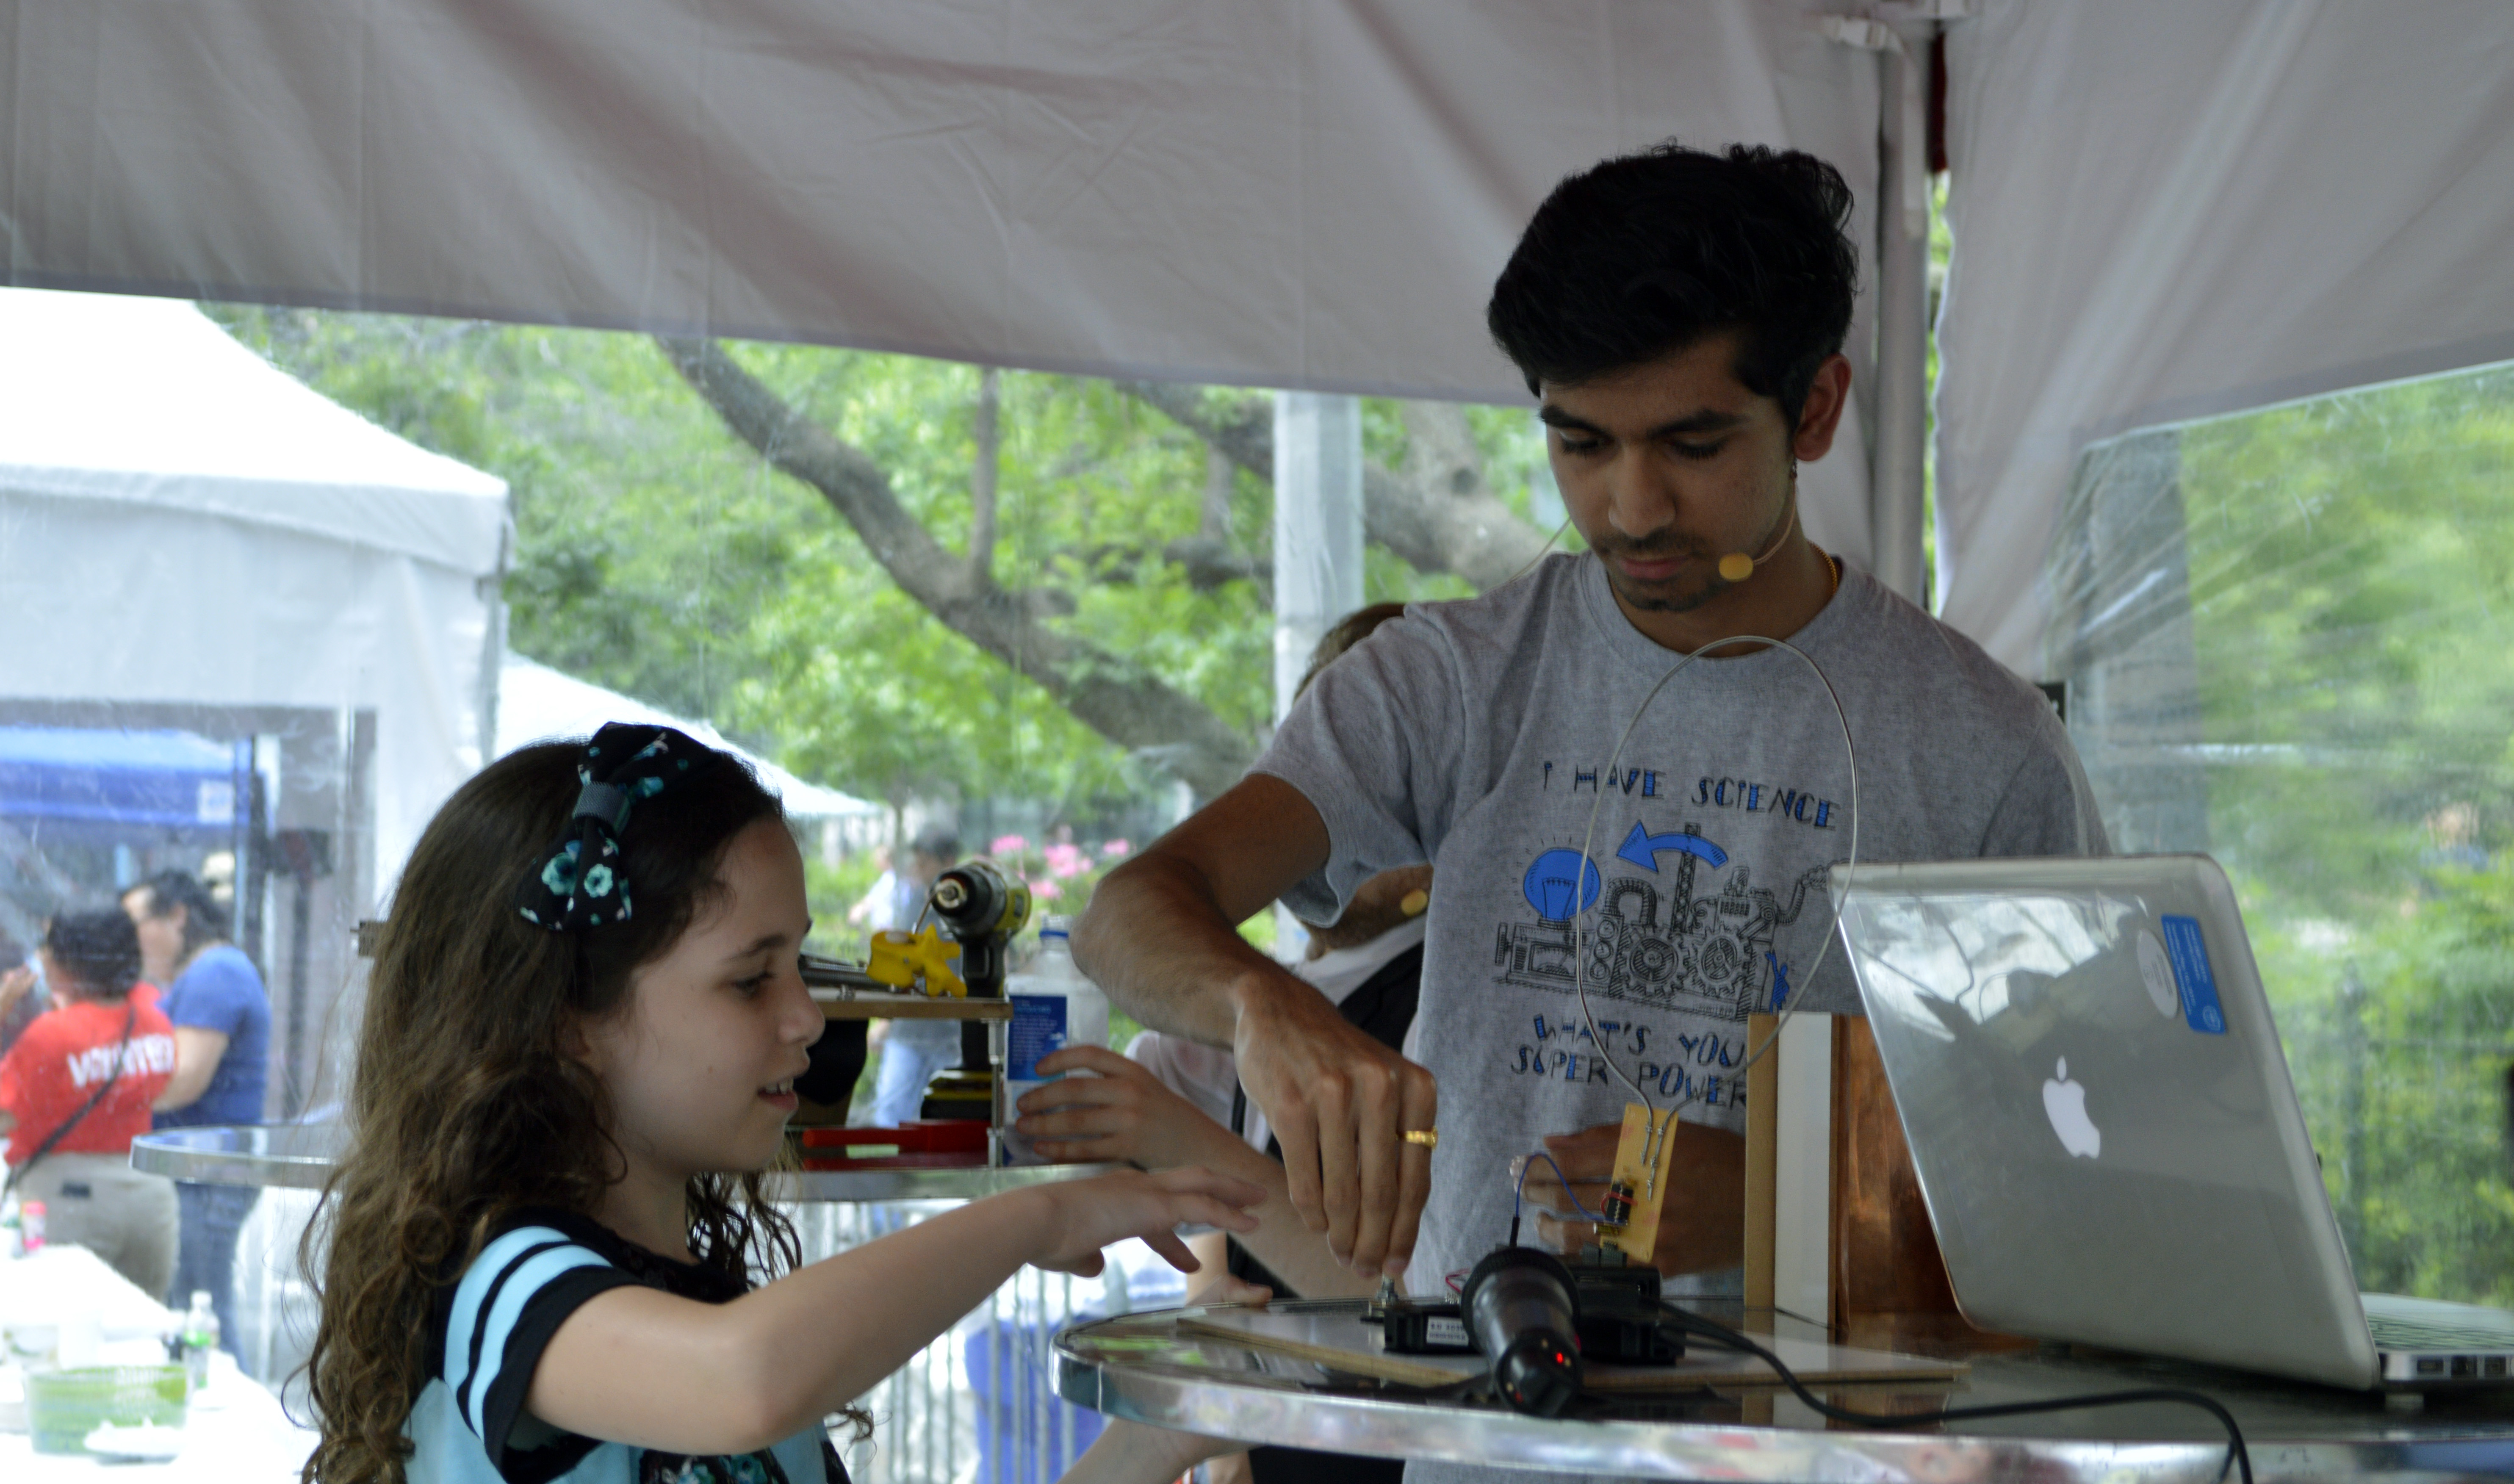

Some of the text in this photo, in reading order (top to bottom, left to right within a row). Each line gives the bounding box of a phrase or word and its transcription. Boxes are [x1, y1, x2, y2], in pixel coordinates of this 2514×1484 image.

[1544, 761, 1841, 831] I HAVE SCIENCE
[1534, 1013, 1747, 1074] WHAT'S YOU
[1511, 1044, 1747, 1110] SUPER POWER
